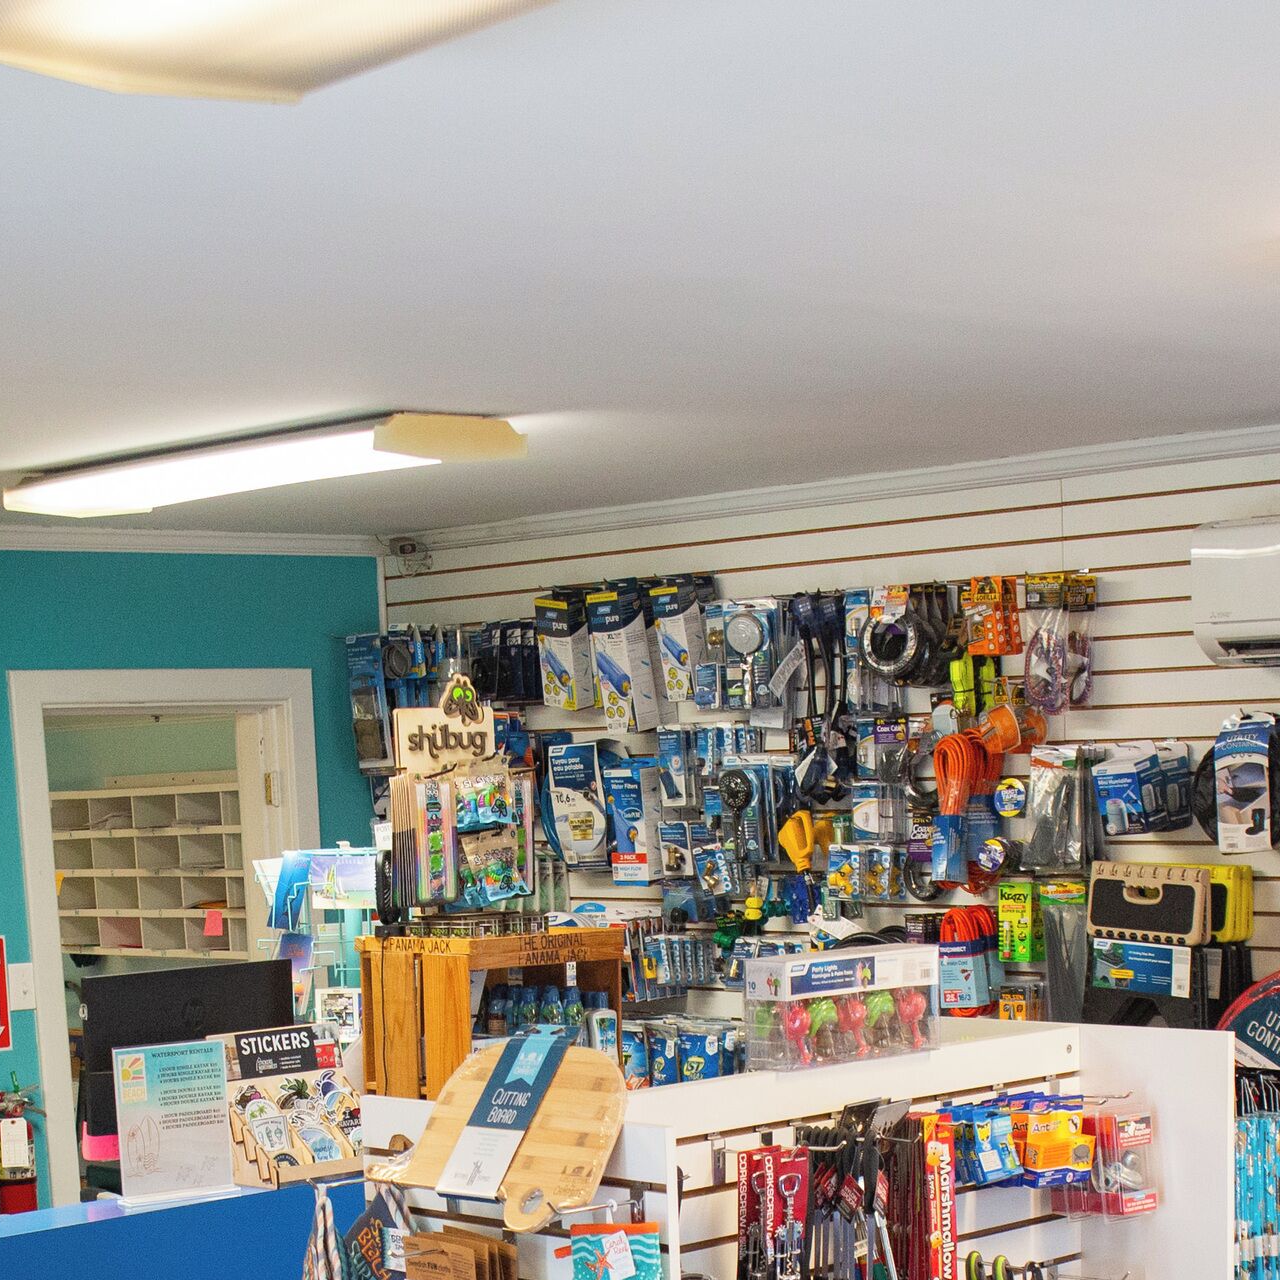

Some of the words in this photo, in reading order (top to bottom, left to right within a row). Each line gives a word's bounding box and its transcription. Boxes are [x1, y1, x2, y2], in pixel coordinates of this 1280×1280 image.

[715, 852, 732, 891] CAMCO
[389, 938, 425, 951] PANAMA
[428, 939, 451, 953] JACK
[541, 933, 585, 949] ORIGINAL
[748, 981, 756, 990] 10
[240, 1031, 310, 1056] STICKERS
[151, 1050, 188, 1058] WATERSPORT
[492, 1088, 530, 1107] CUTTING
[487, 1106, 517, 1124] BOARD
[738, 1153, 747, 1228] CORKSCREW
[764, 1157, 775, 1232] CORKSCREW
[938, 1143, 954, 1280] Marshmallow
